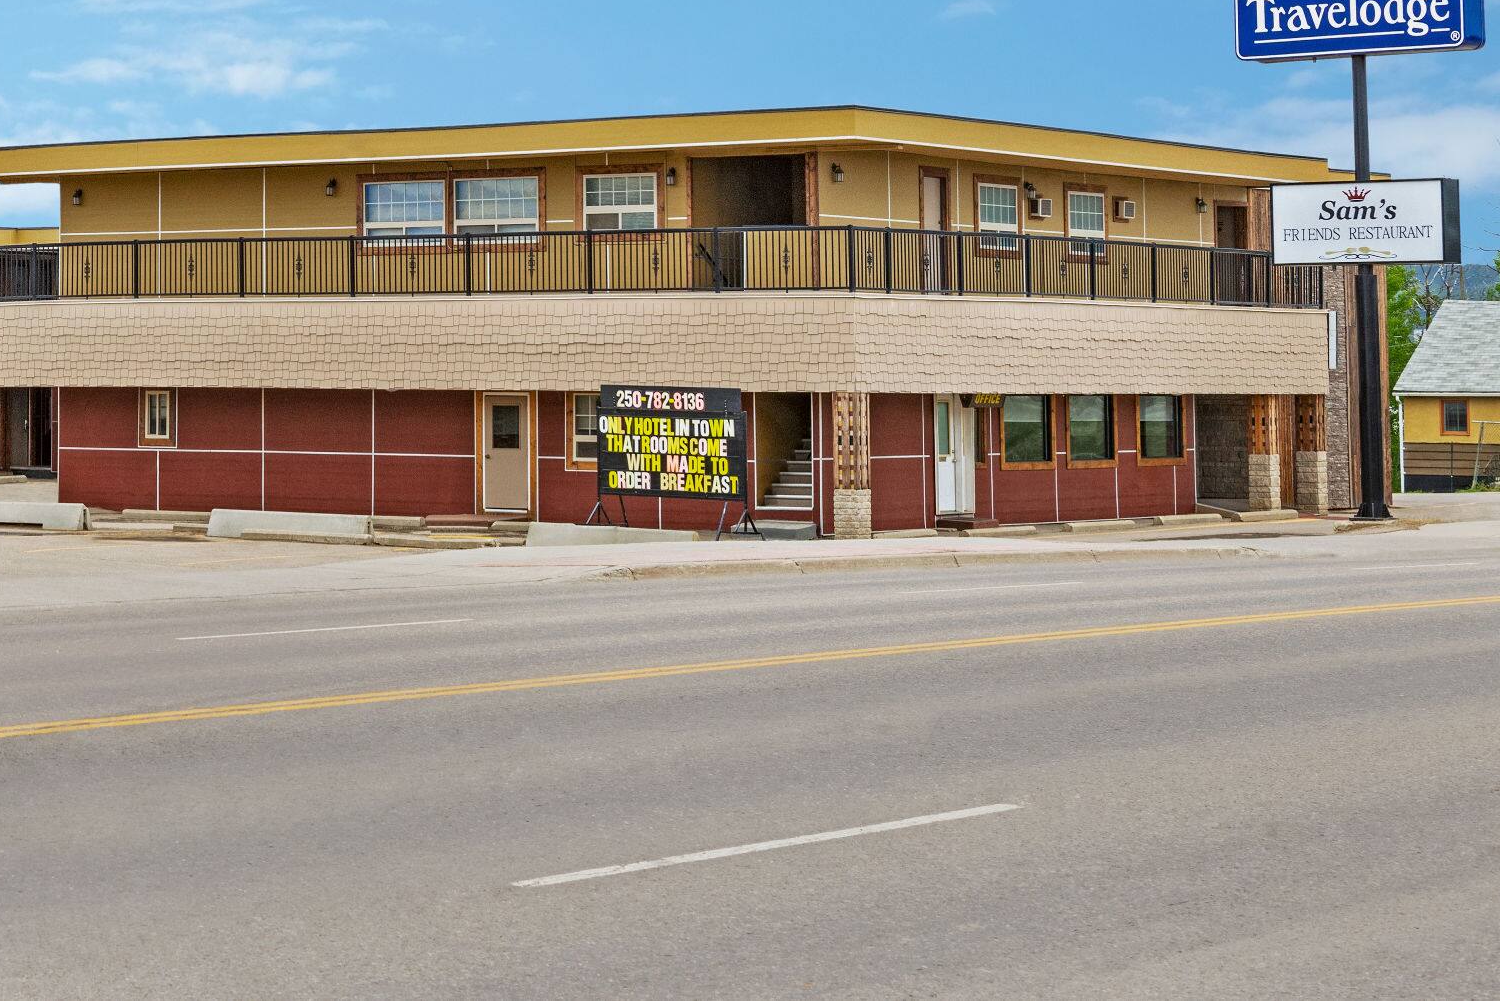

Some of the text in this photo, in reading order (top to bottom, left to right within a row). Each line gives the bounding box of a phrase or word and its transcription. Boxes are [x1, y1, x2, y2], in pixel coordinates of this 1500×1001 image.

[1318, 199, 1397, 220] Sam's
[1283, 225, 1433, 242] FRIENDS RESTAURANT
[616, 390, 705, 411] 250-782-8136
[975, 393, 1001, 404] OFFICE
[599, 416, 735, 437] ONLY HOTEL IN TOWN
[606, 435, 728, 457] THAT ROOMS COME
[626, 453, 729, 475] WITH MADE TO
[608, 471, 739, 494] ORDER BREAKFAST
